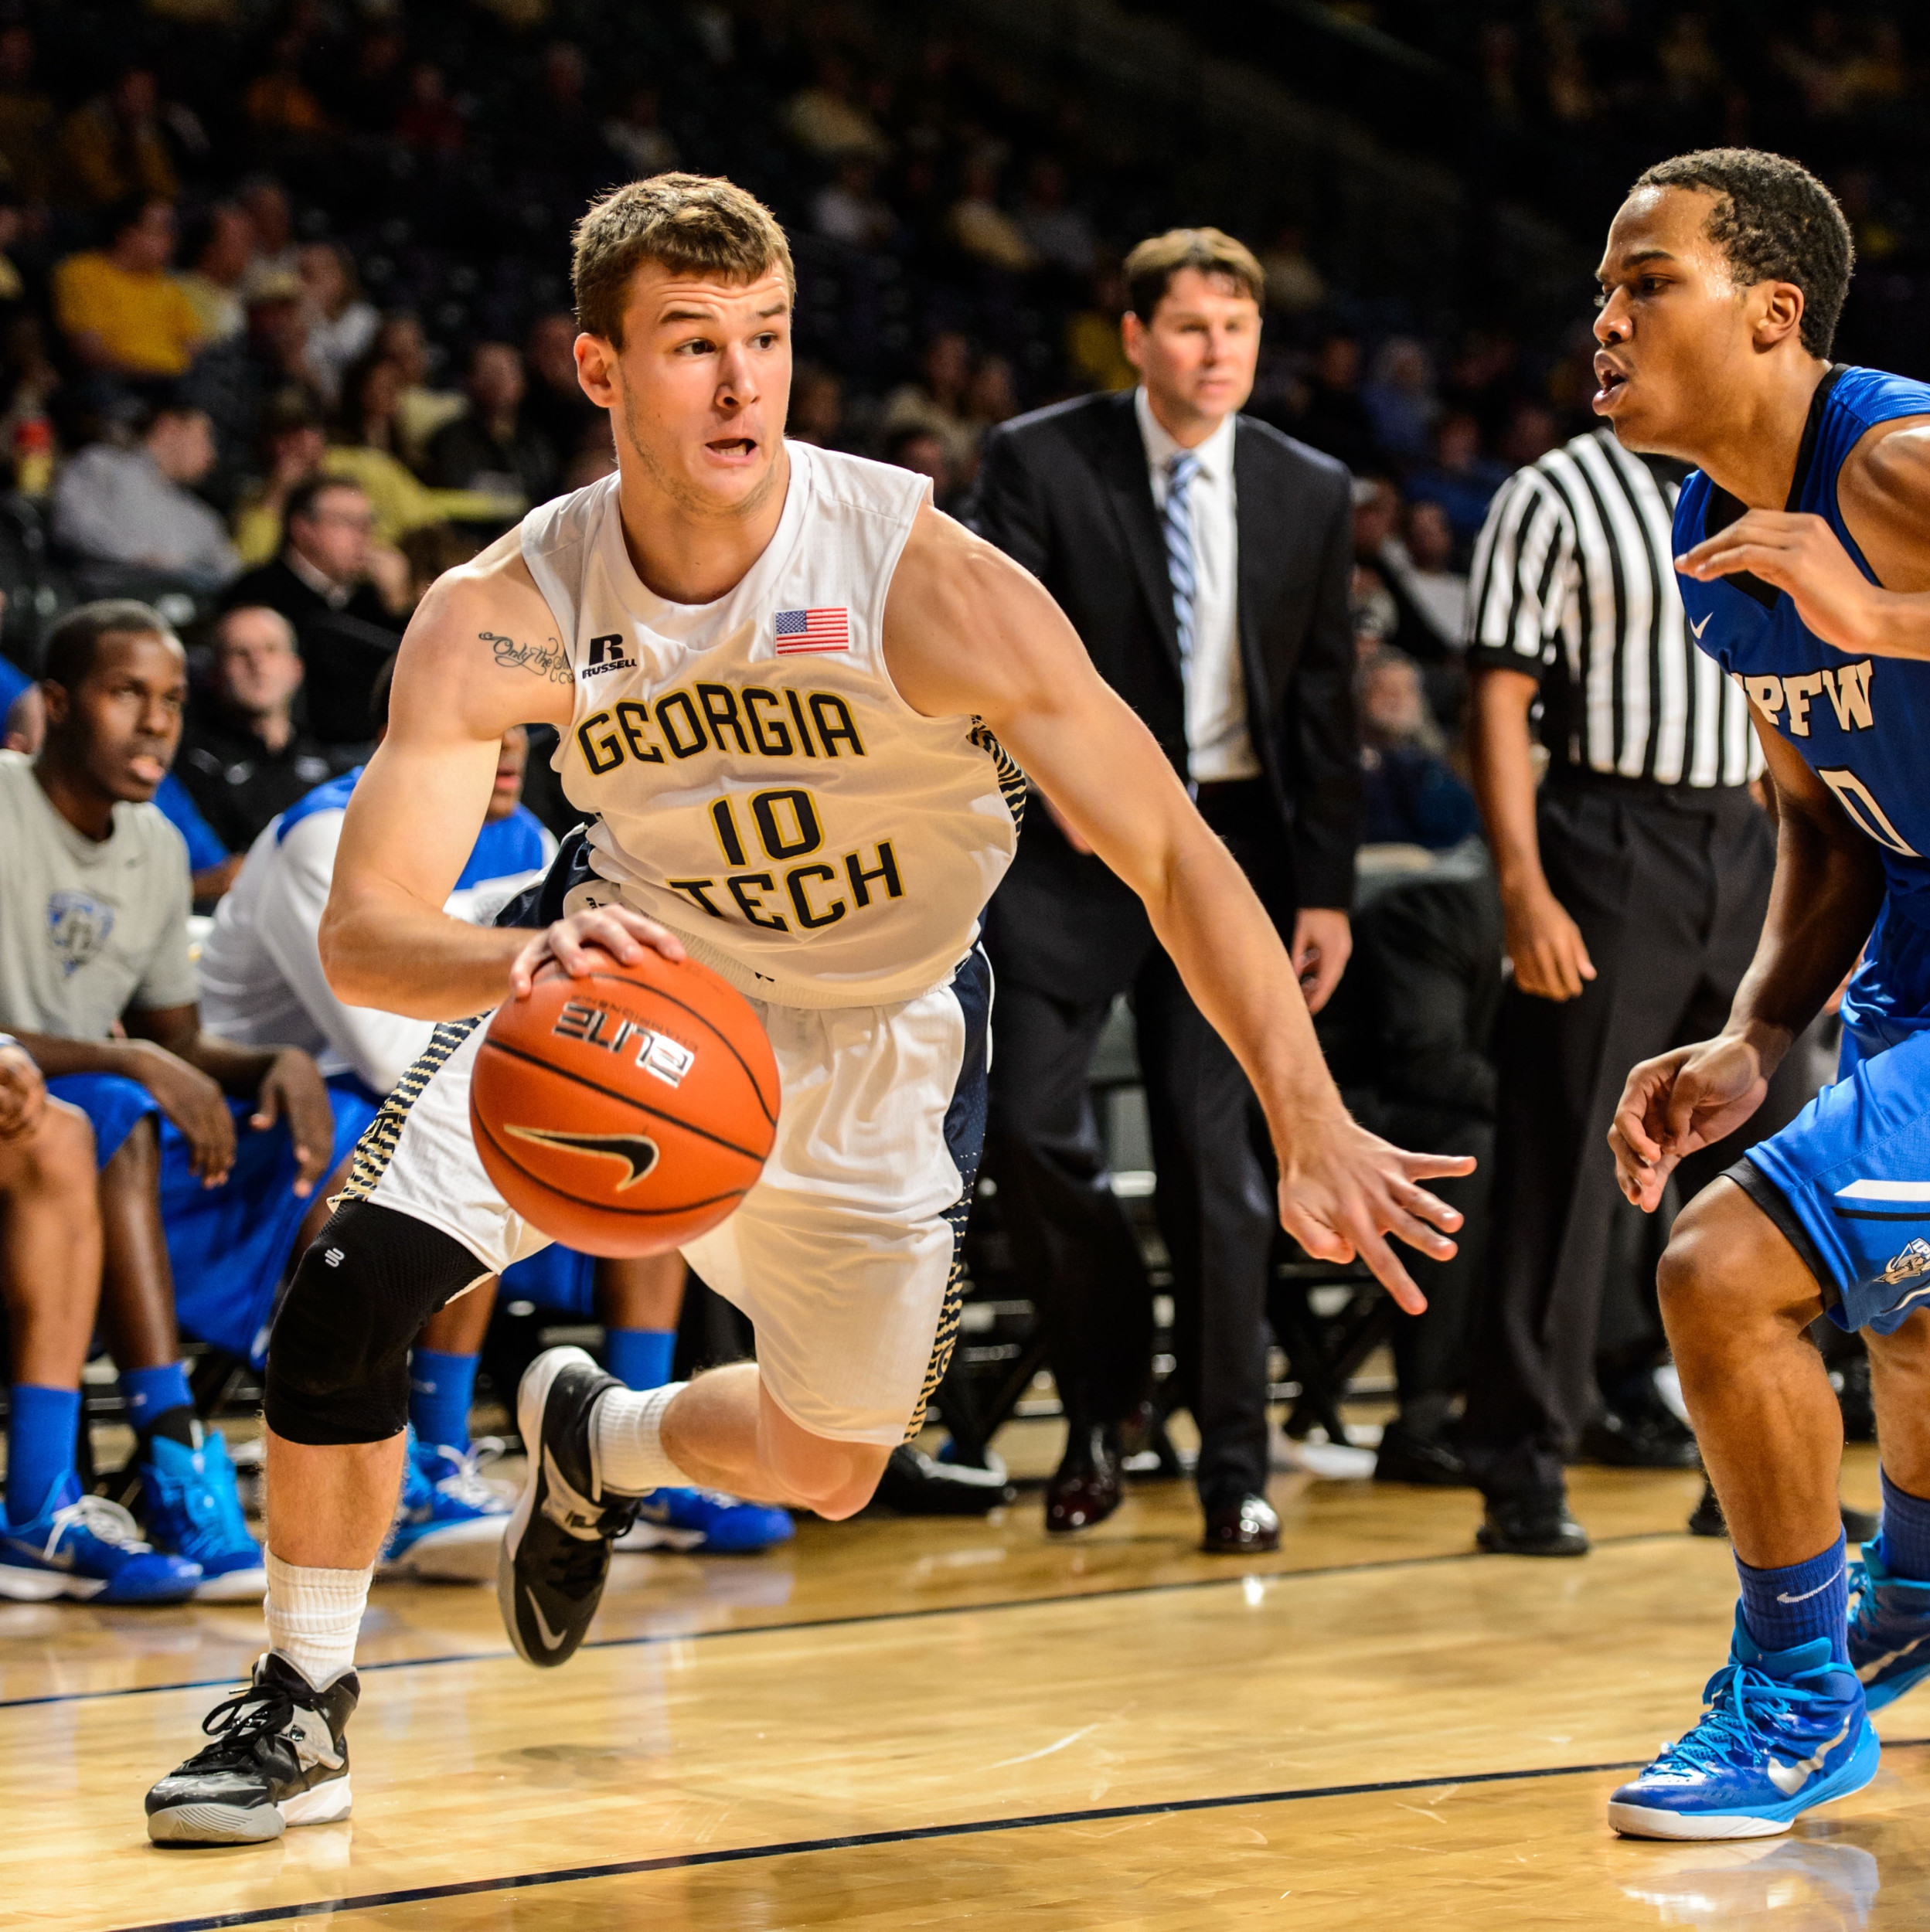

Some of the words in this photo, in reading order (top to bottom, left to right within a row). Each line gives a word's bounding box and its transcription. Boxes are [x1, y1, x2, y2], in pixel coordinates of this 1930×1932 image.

[582, 658, 637, 680] RUSSELL
[1731, 659, 1874, 736] PFW
[577, 681, 866, 775] GEORGIA
[708, 787, 825, 868] 10
[666, 838, 906, 934] TECH
